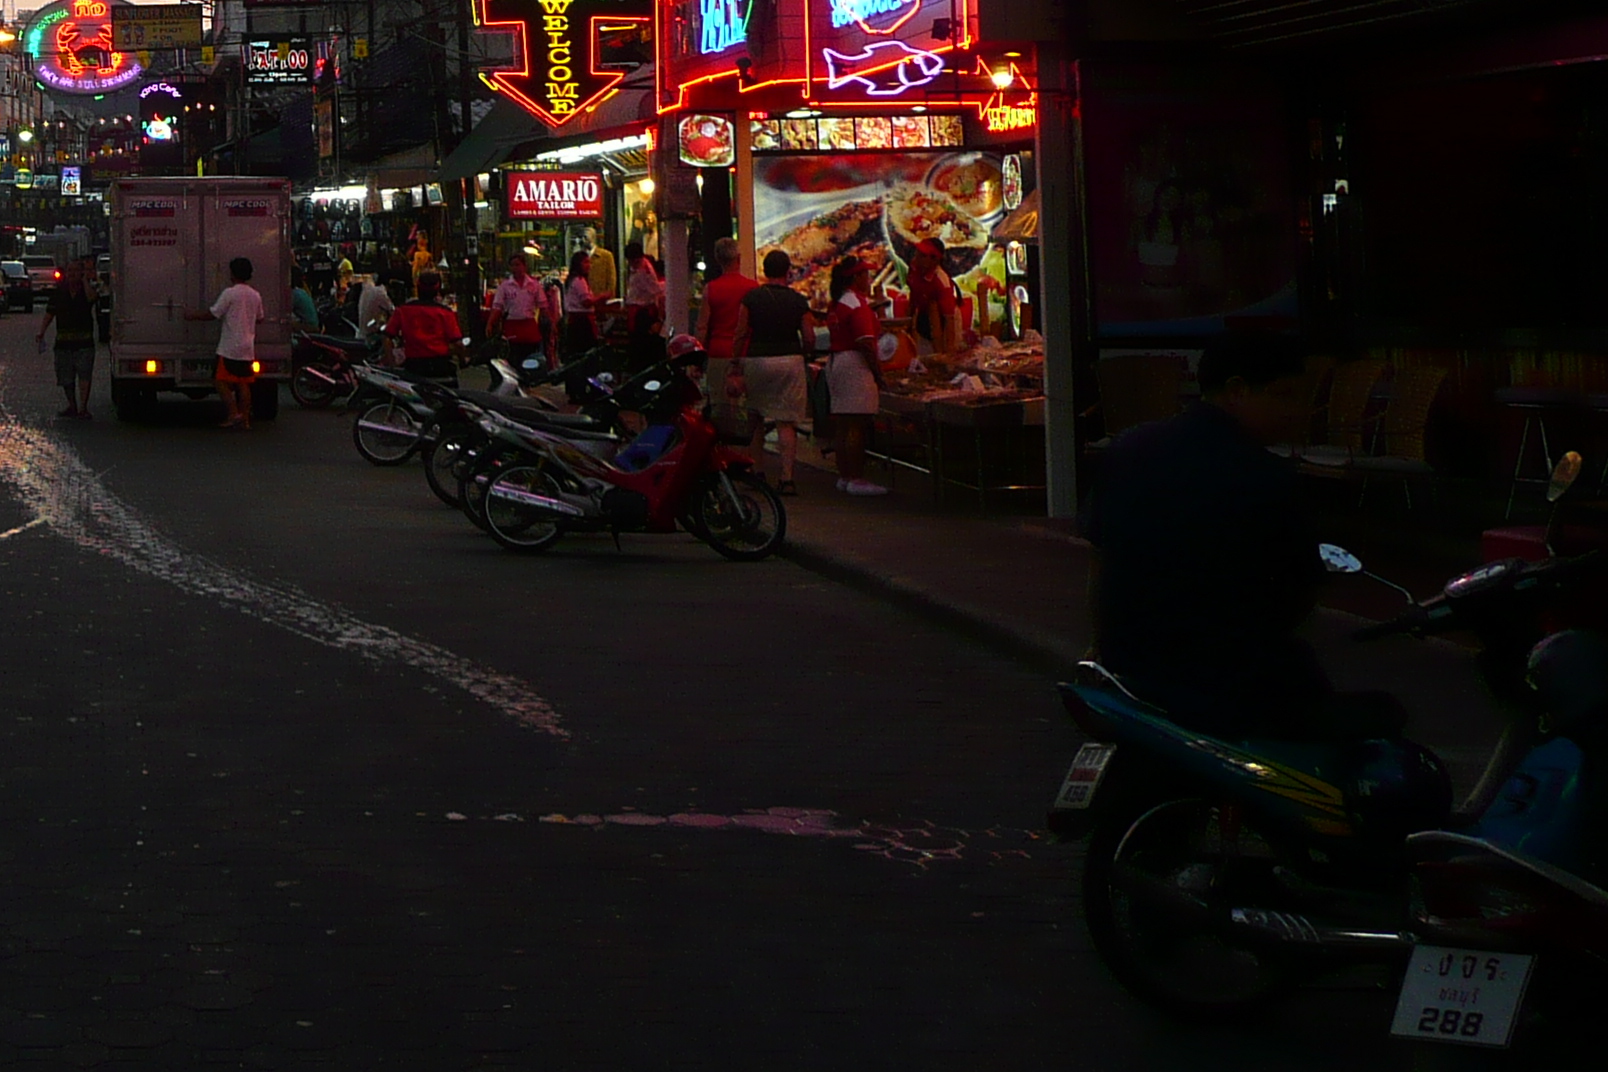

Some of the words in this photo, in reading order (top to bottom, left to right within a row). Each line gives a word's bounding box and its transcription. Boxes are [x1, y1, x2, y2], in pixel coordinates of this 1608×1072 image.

[513, 179, 599, 202] AMARIO
[536, 201, 576, 210] TAILOR
[1418, 1007, 1484, 1037] 288
